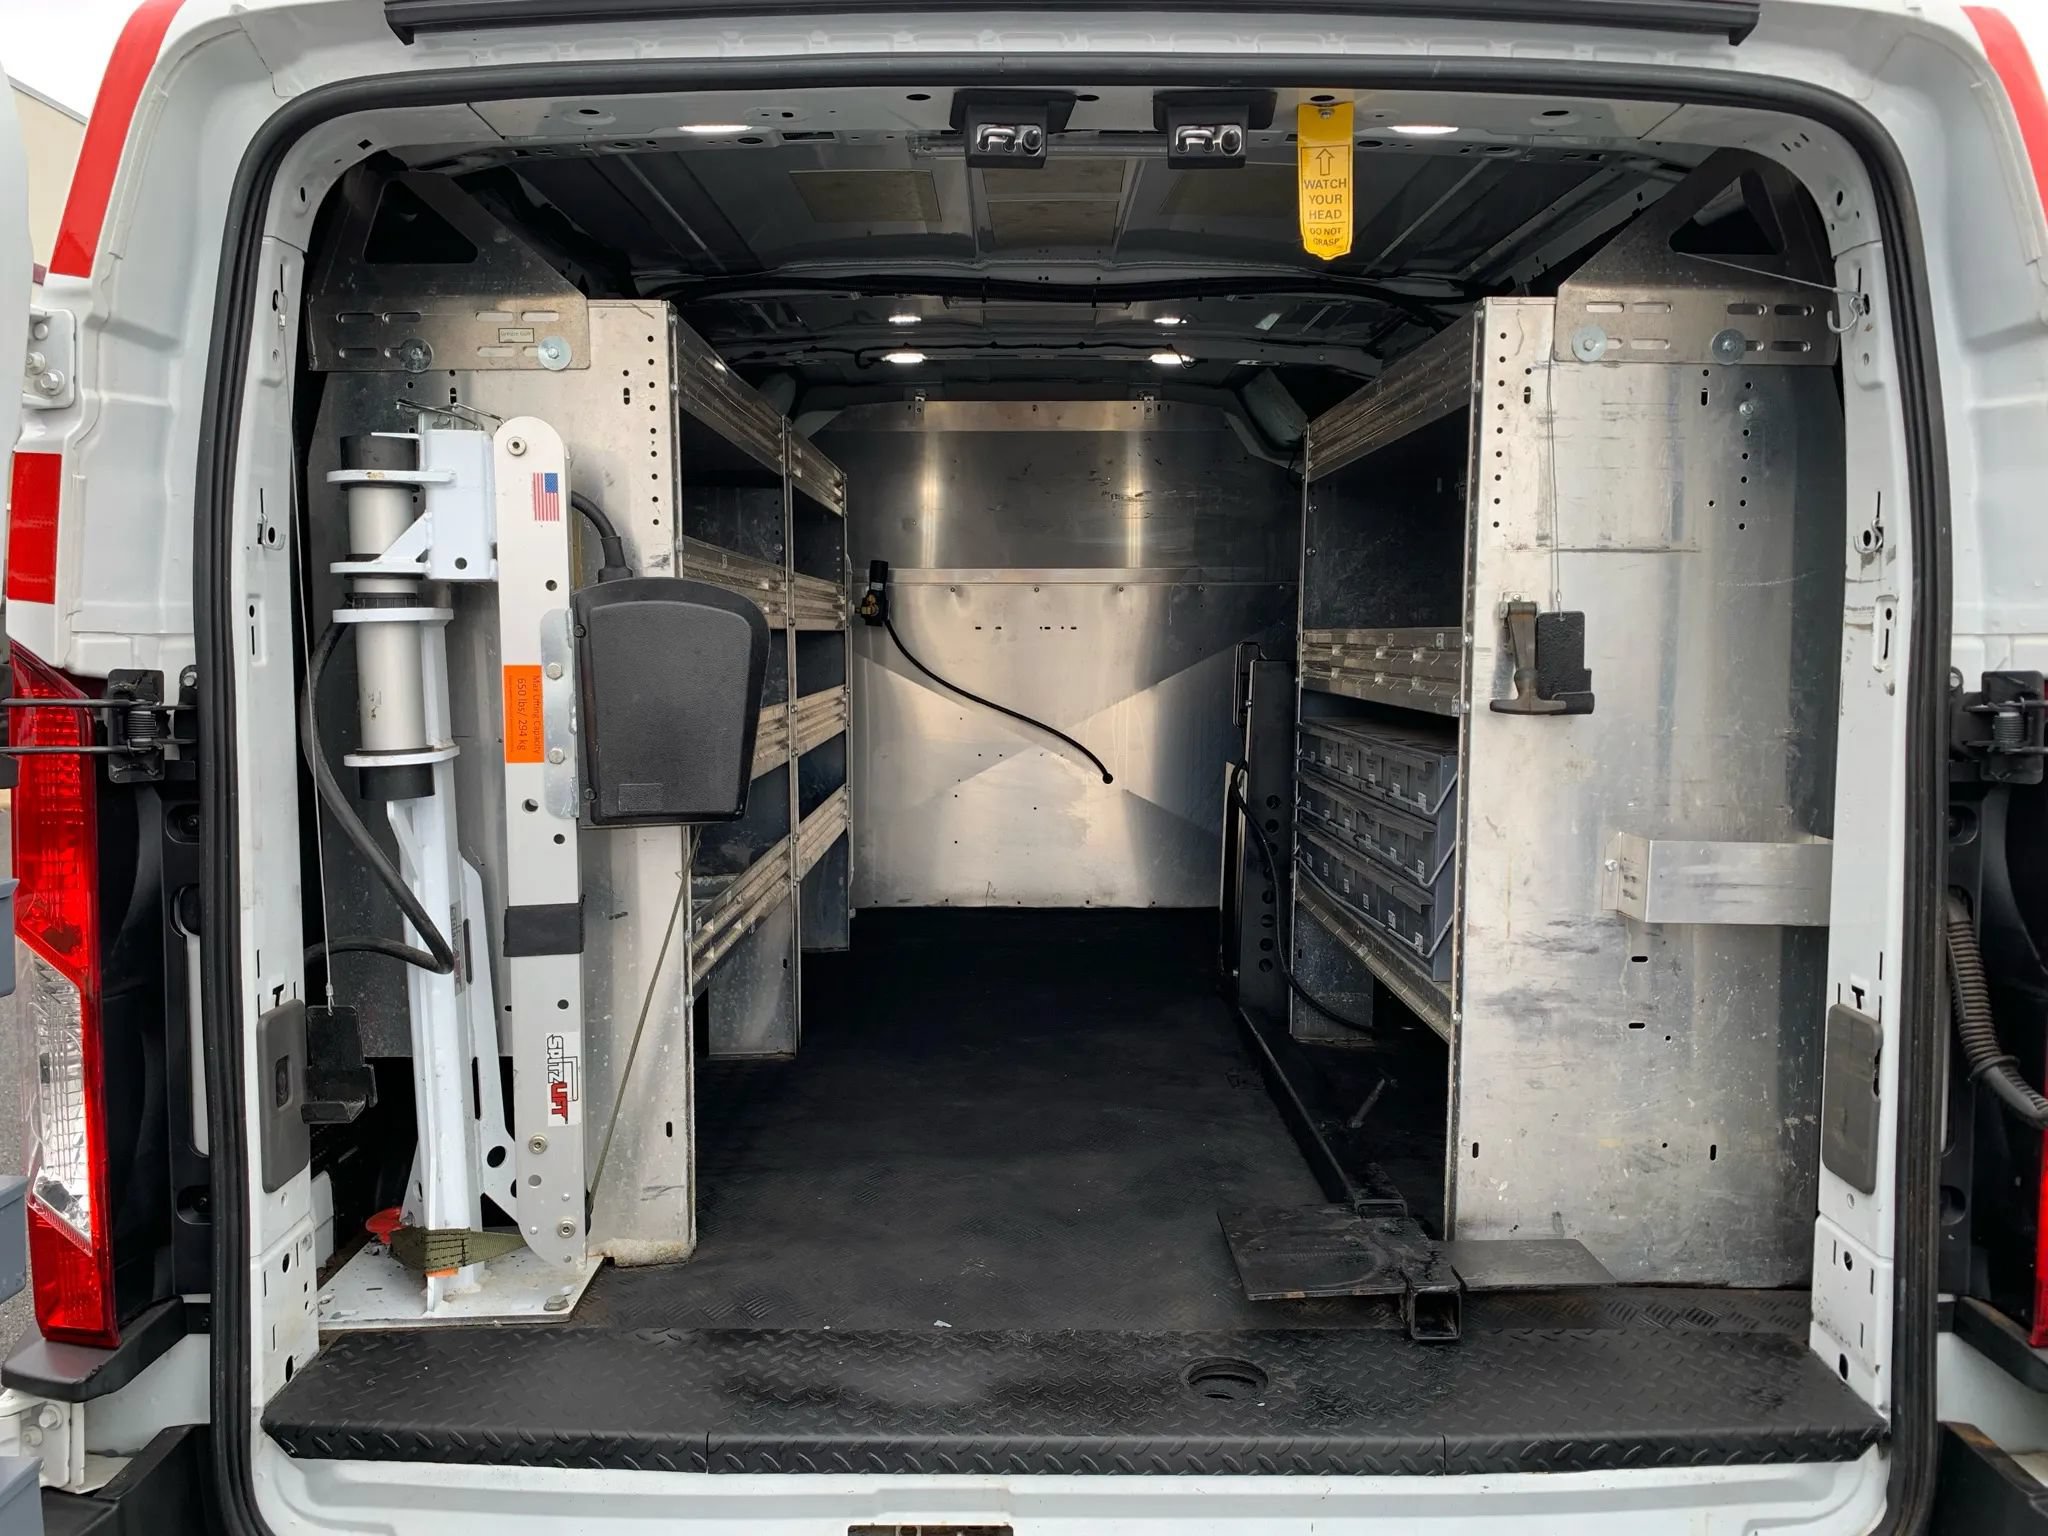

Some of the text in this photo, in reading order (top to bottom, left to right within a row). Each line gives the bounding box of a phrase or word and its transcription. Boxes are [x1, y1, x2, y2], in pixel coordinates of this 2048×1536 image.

[1304, 178, 1347, 190] WATCH
[1309, 194, 1342, 205] YOUR
[1309, 209, 1342, 220] HEAD
[1310, 227, 1342, 236] DO NOT
[1313, 238, 1341, 247] GRASP
[517, 678, 527, 696] 650
[518, 719, 528, 737] 294
[532, 720, 542, 754] Capacity
[517, 740, 528, 752] kg
